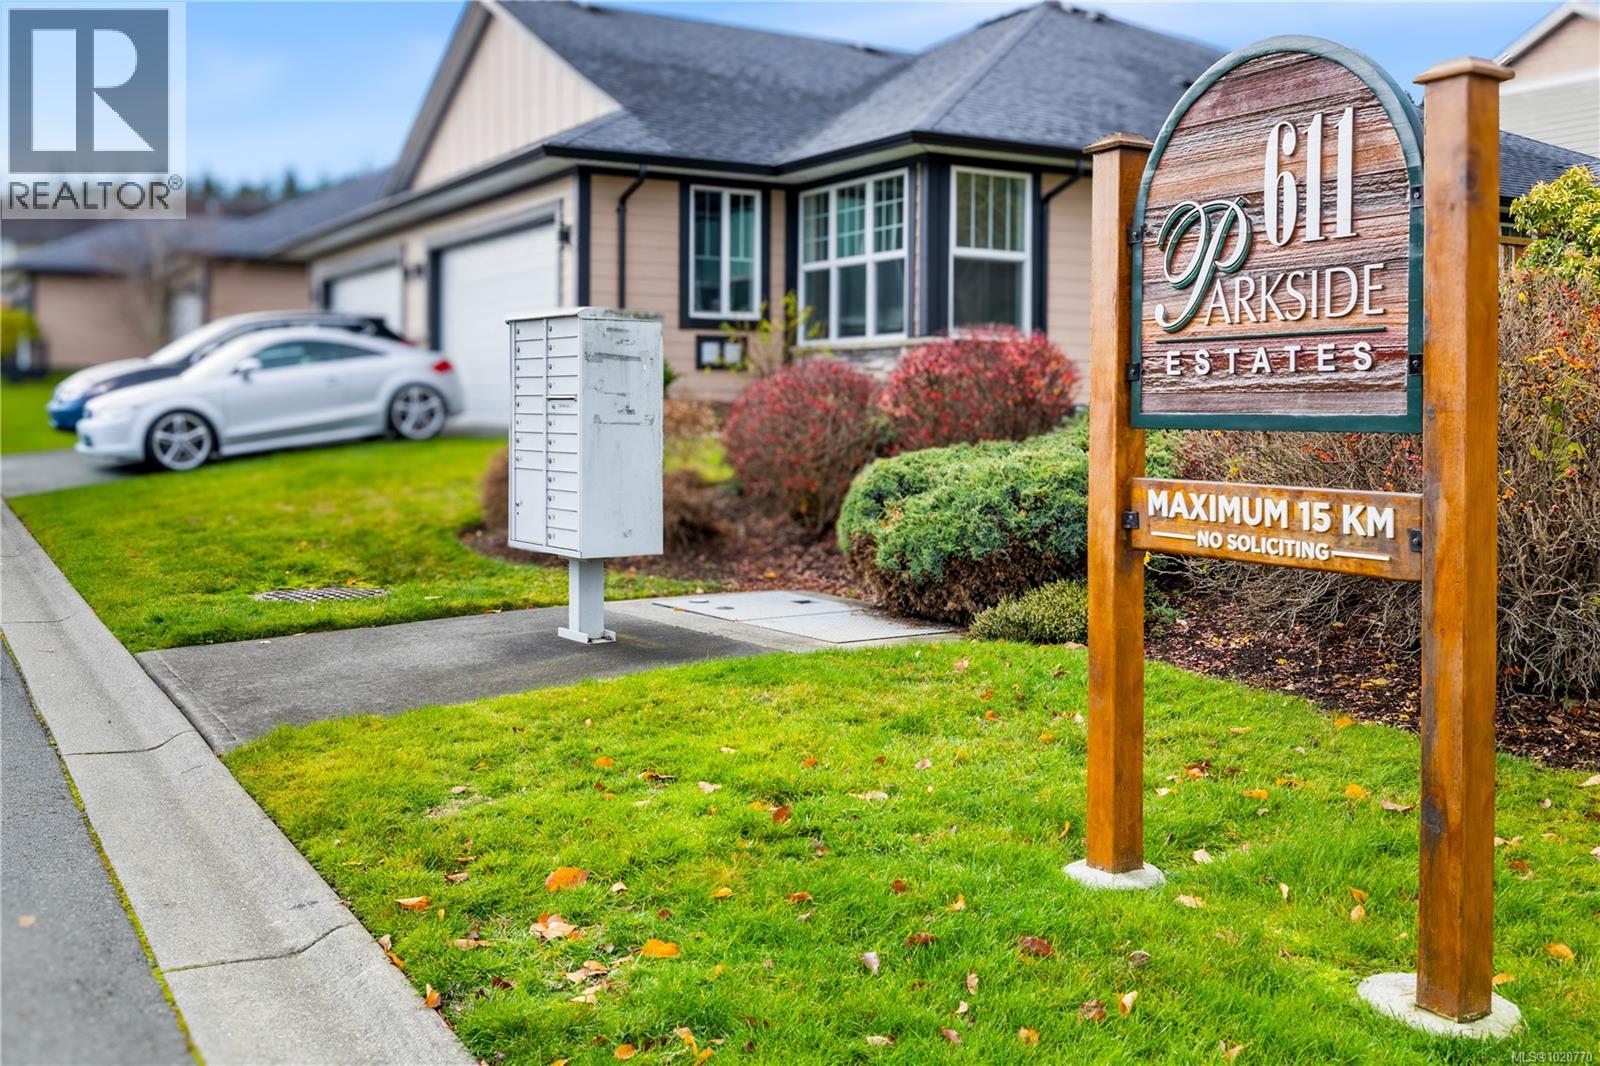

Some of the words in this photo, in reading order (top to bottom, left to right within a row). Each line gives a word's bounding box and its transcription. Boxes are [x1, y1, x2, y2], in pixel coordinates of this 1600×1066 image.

[1264, 107, 1356, 246] 611
[1156, 197, 1384, 333] PARKSIDE
[1166, 342, 1373, 376] ESTATES
[1147, 489, 1289, 528] MAXIMUM
[1299, 501, 1332, 532] 15
[1342, 504, 1395, 539] KM
[1197, 530, 1223, 549] NO
[1226, 535, 1330, 561] SOLICITING
